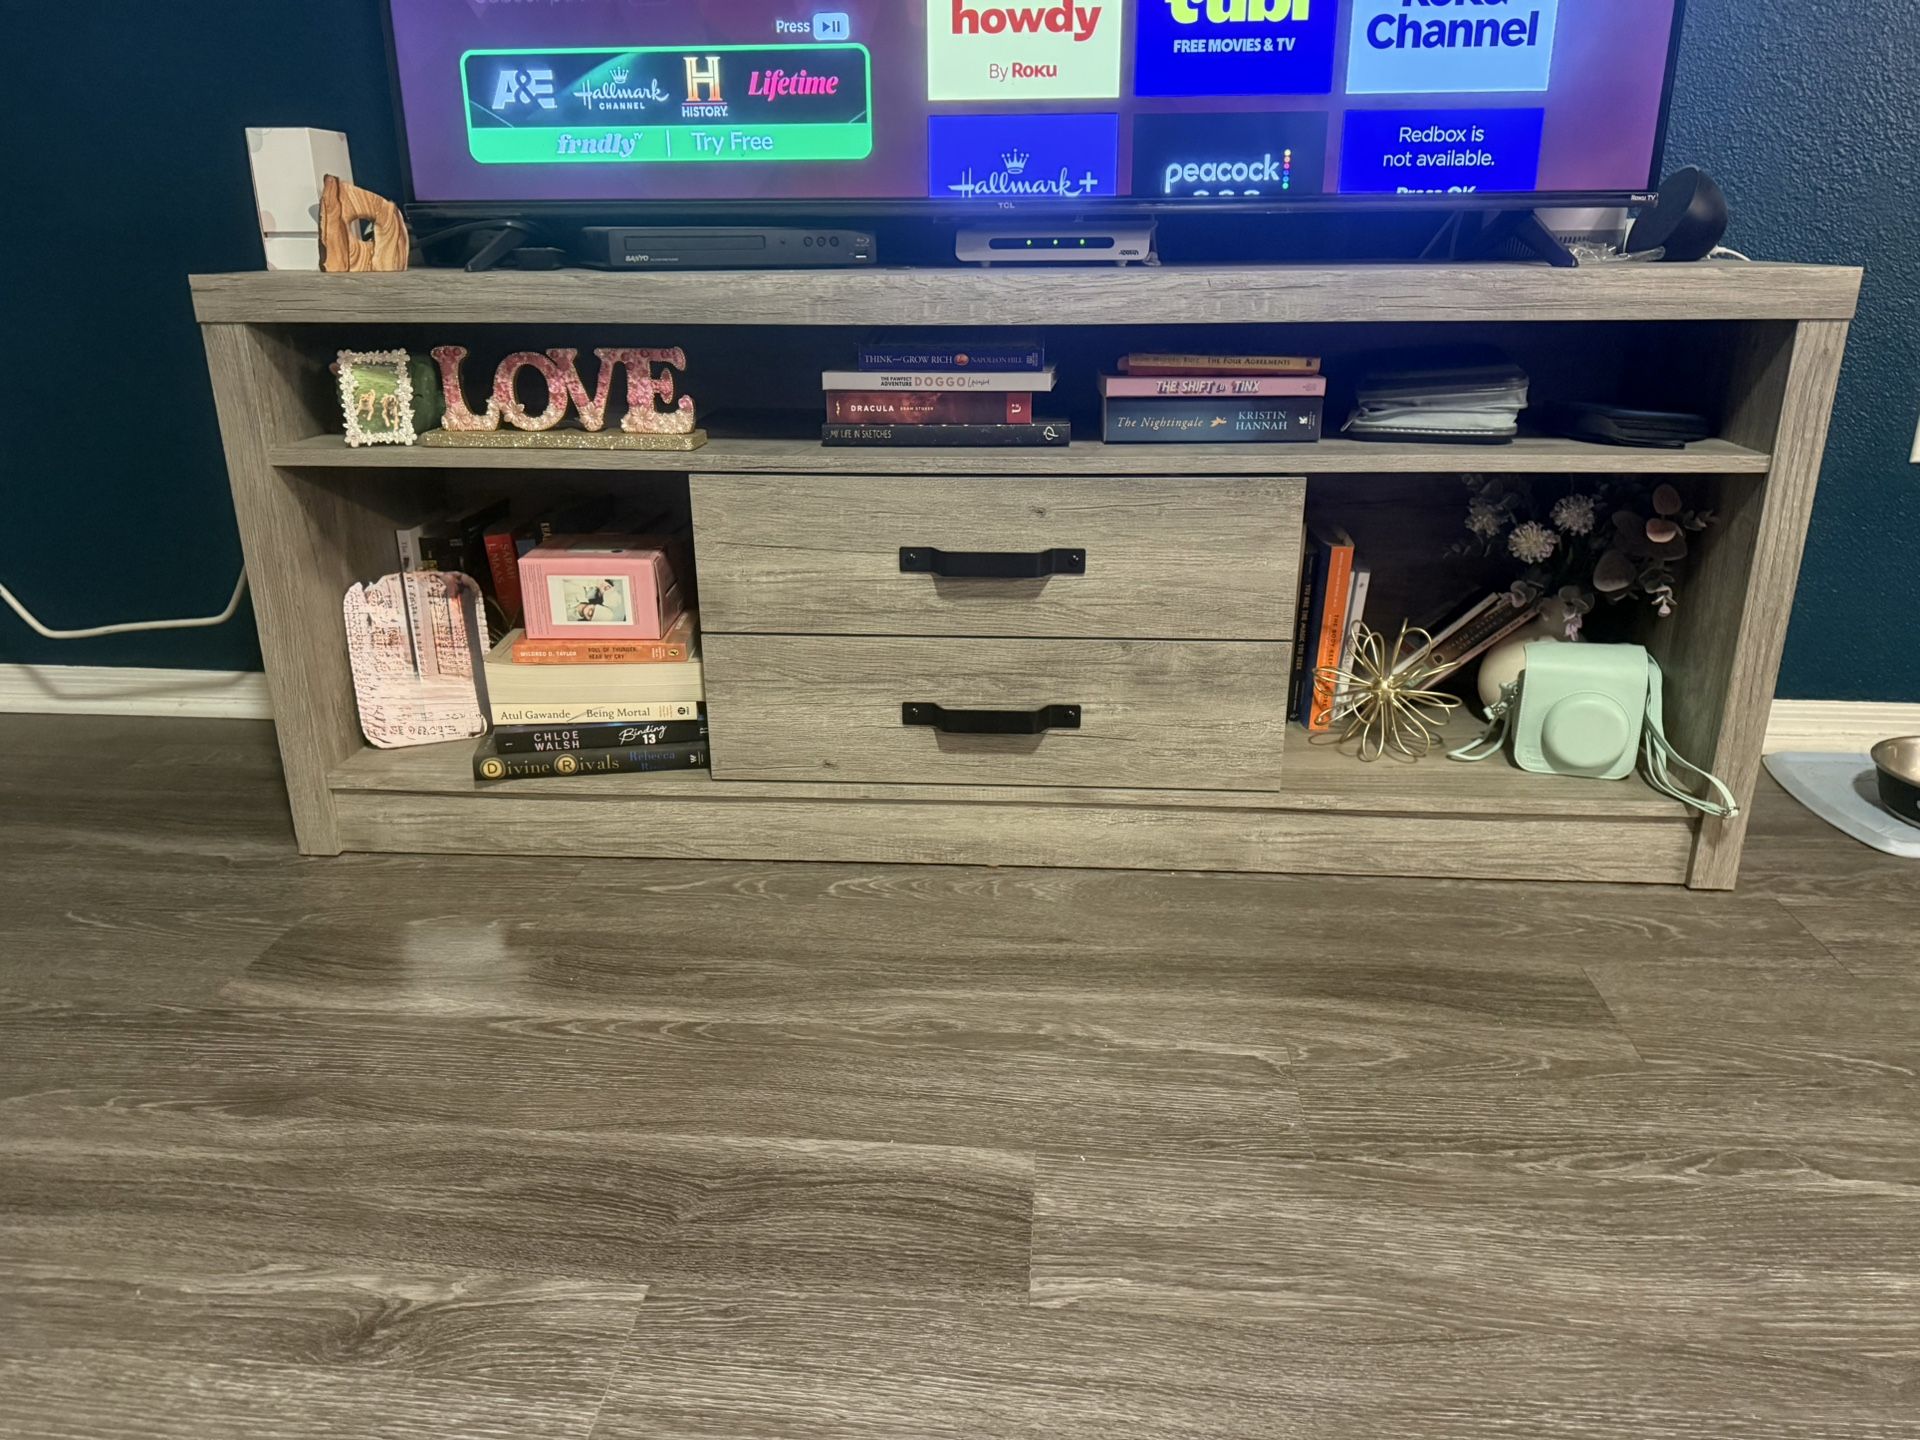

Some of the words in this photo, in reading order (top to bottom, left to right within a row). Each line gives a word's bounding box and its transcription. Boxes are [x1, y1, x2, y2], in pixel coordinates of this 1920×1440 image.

[776, 19, 810, 34] Press
[951, 0, 1102, 41] howdy
[1367, 10, 1540, 49] Channel
[1173, 39, 1207, 53] FREE
[1208, 38, 1262, 53] MOVIES
[1263, 37, 1274, 52] &
[1277, 37, 1296, 52] TV
[682, 55, 723, 103] H
[989, 63, 1008, 82] By
[491, 69, 557, 110] A&E
[573, 78, 669, 110] Hallmark
[748, 71, 839, 101] Lifetime
[599, 102, 646, 110] CHANNEL
[681, 105, 729, 118] HISTORY
[1399, 125, 1467, 143] Redbox
[1471, 125, 1485, 142] is
[556, 133, 635, 158] frndly
[690, 132, 724, 155] Try
[730, 131, 774, 151] Free
[1383, 151, 1412, 167] not
[1416, 150, 1495, 167] available.
[1164, 153, 1280, 194] peacock
[999, 202, 1016, 210] TCL
[864, 355, 893, 364] THINK
[903, 355, 930, 364] GROW
[931, 355, 953, 364] RICH
[431, 345, 695, 434] LOVE
[915, 376, 966, 387] DOGGO
[1155, 380, 1179, 394] THE
[1181, 380, 1216, 395] SHIFT
[851, 405, 895, 413] DRACULA
[1238, 411, 1288, 420] KRISTIN
[1117, 416, 1137, 428] The
[1140, 416, 1204, 431] Nightingale
[1235, 420, 1288, 431] HANNAH
[500, 710, 524, 721] Atul
[525, 710, 571, 720] Gawande
[586, 708, 615, 720] Being
[616, 707, 650, 718] Mortal
[533, 730, 580, 741] CHLOE
[618, 725, 667, 745] Binding
[642, 733, 656, 745] 13
[533, 741, 580, 752] WALSH
[483, 758, 550, 777] Divine
[557, 754, 620, 774] Rivals
